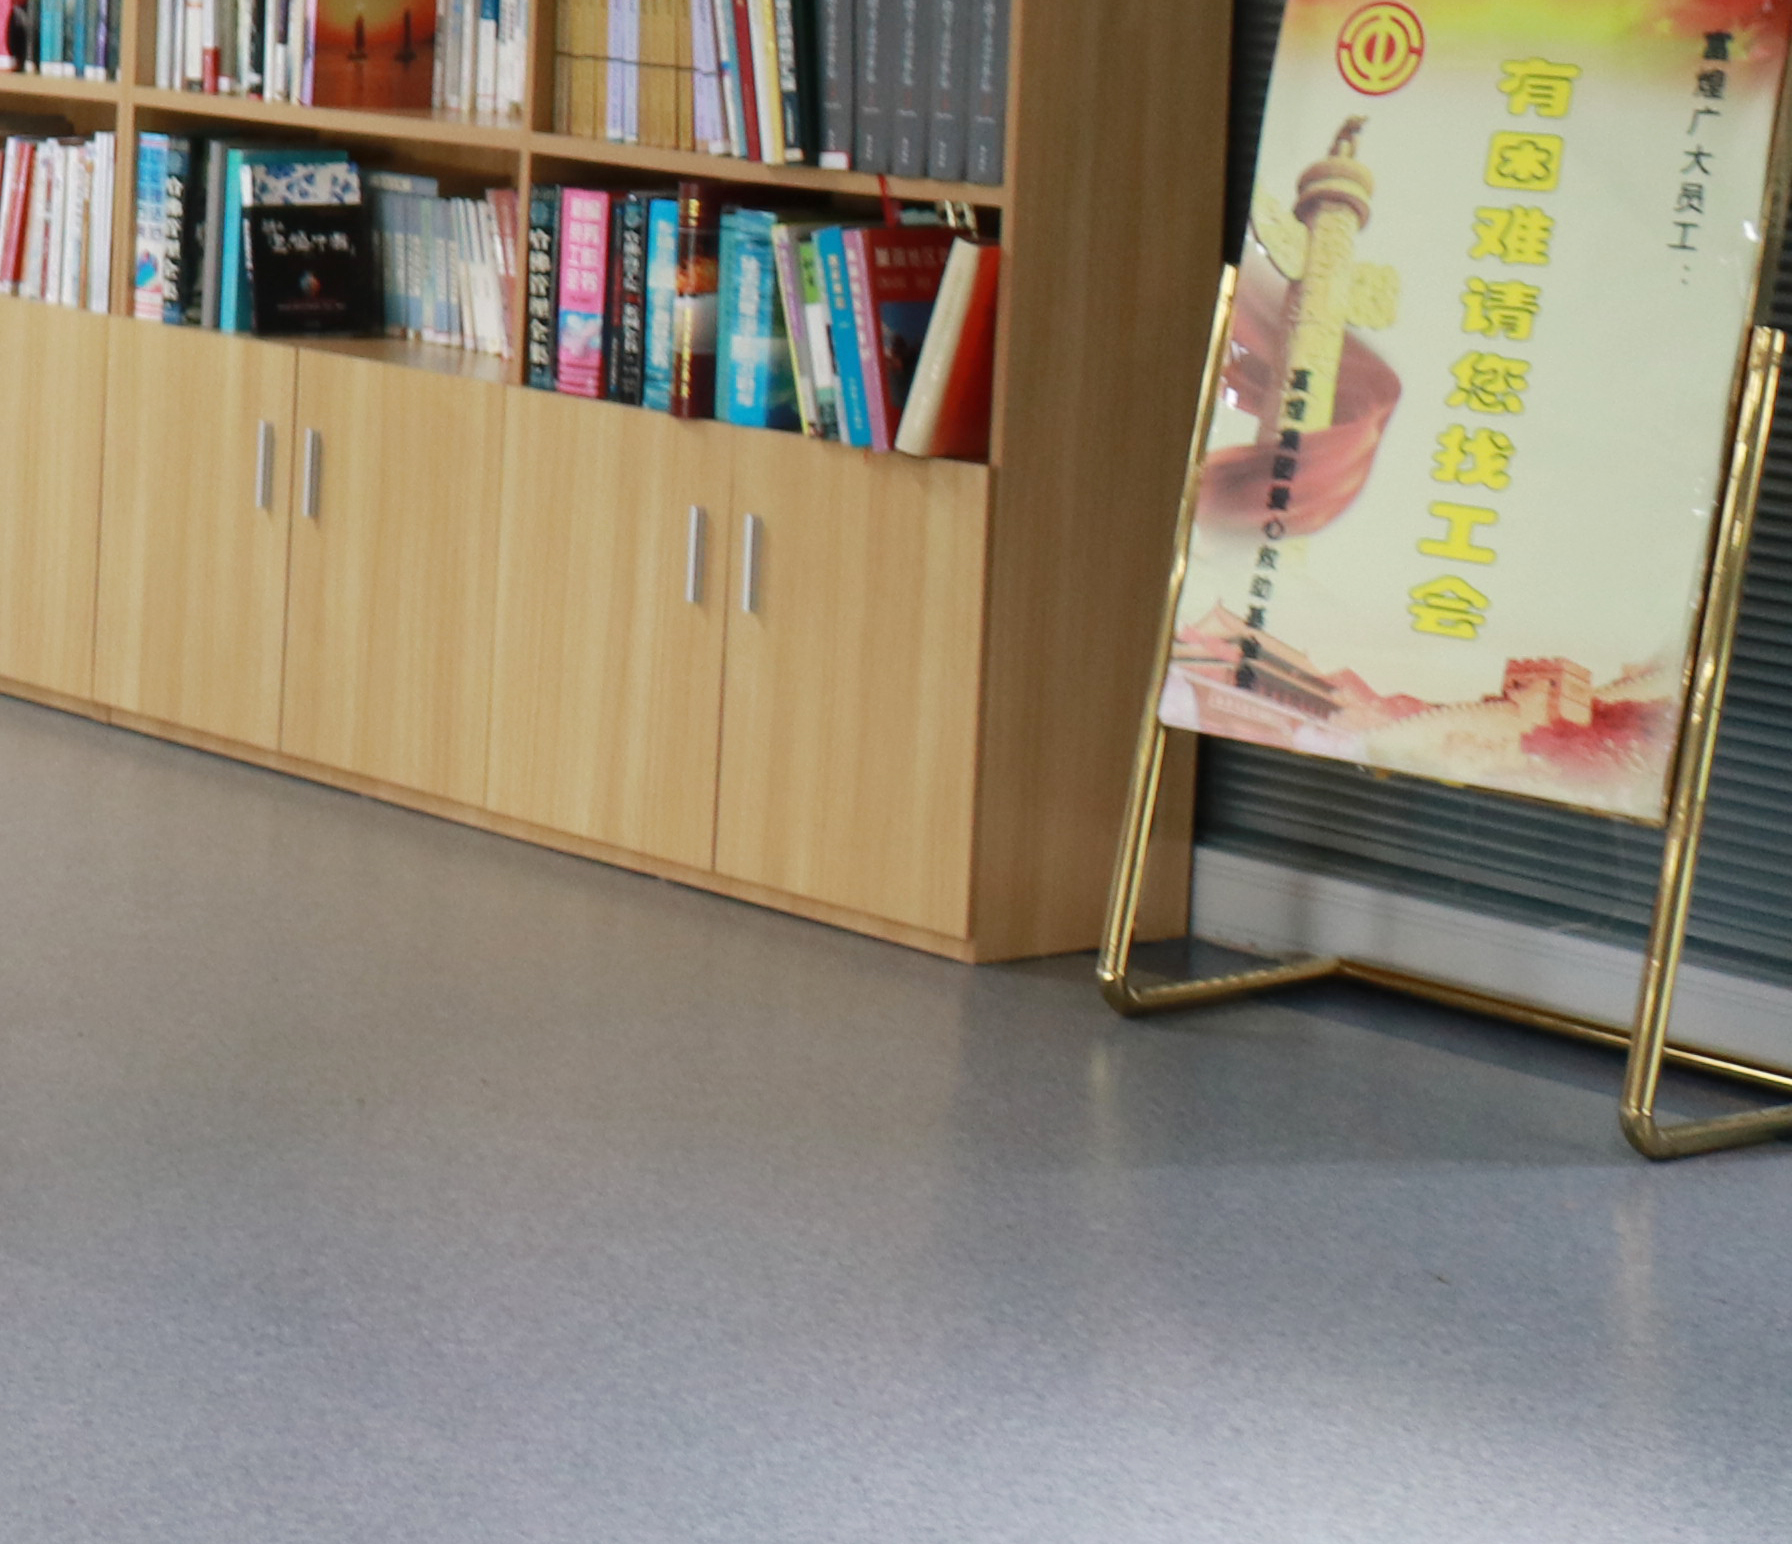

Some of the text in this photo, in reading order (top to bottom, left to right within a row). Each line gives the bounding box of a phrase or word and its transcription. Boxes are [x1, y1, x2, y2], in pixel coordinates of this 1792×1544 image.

[1407, 56, 1583, 640] 有困难请您找工会
